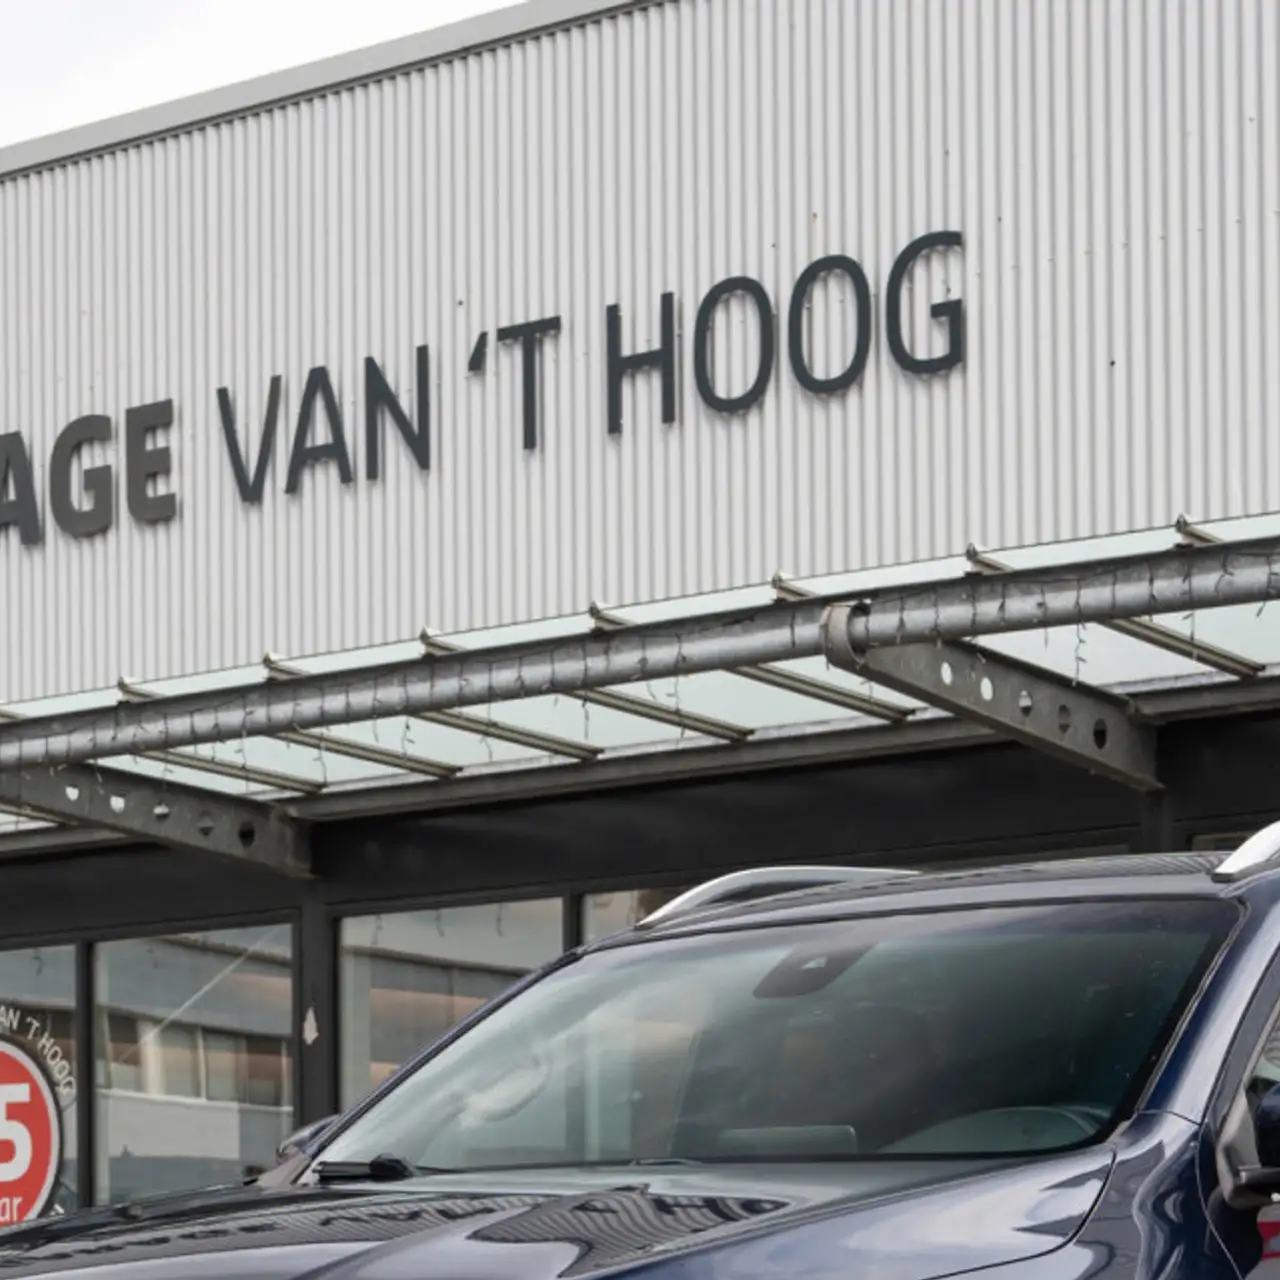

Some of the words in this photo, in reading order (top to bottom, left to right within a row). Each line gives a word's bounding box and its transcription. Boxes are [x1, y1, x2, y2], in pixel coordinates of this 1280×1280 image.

[216, 347, 431, 507] VAN
[605, 230, 967, 435] HOOG
[36, 1032, 77, 1098] HOOG
